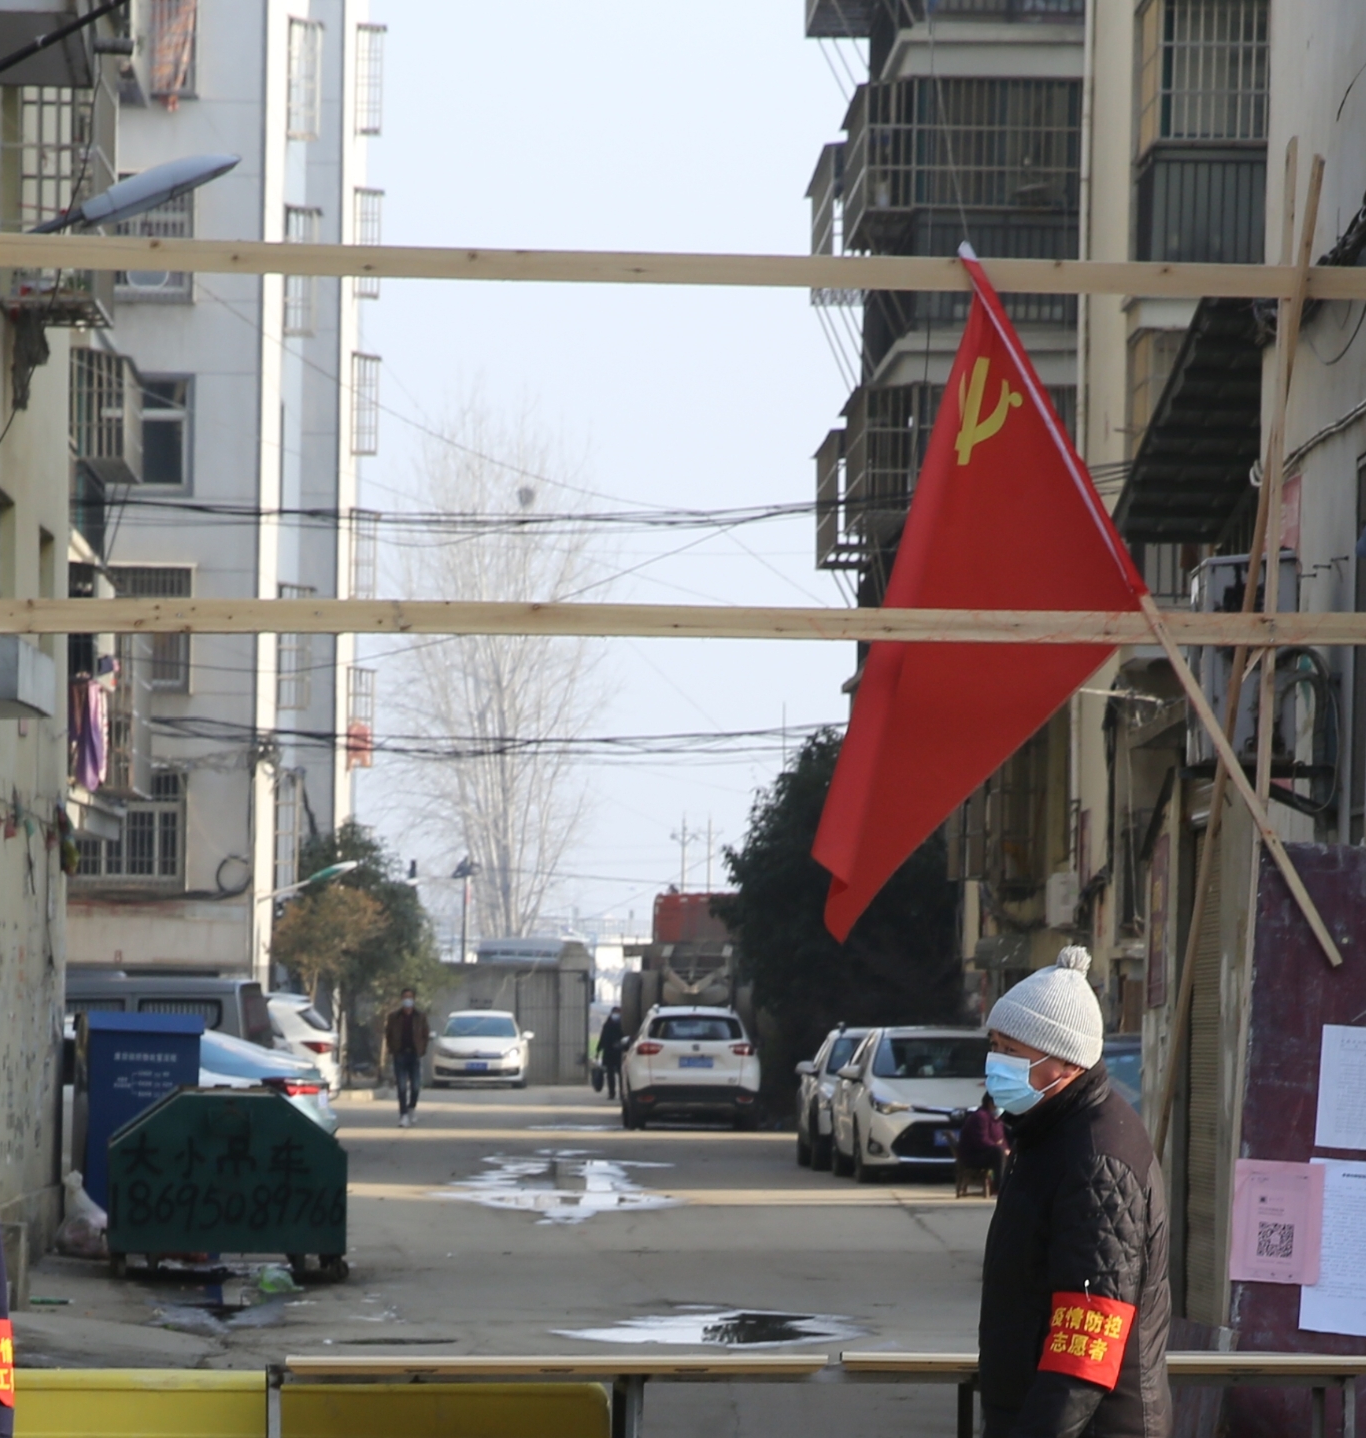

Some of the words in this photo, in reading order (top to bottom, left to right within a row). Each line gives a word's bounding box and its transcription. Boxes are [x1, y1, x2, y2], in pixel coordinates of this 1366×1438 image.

[118, 1130, 312, 1183] 大小吊车
[109, 1180, 348, 1232] 18695089766
[1051, 1306, 1123, 1339] 疫情防控
[1050, 1331, 1109, 1362] 志愿者
